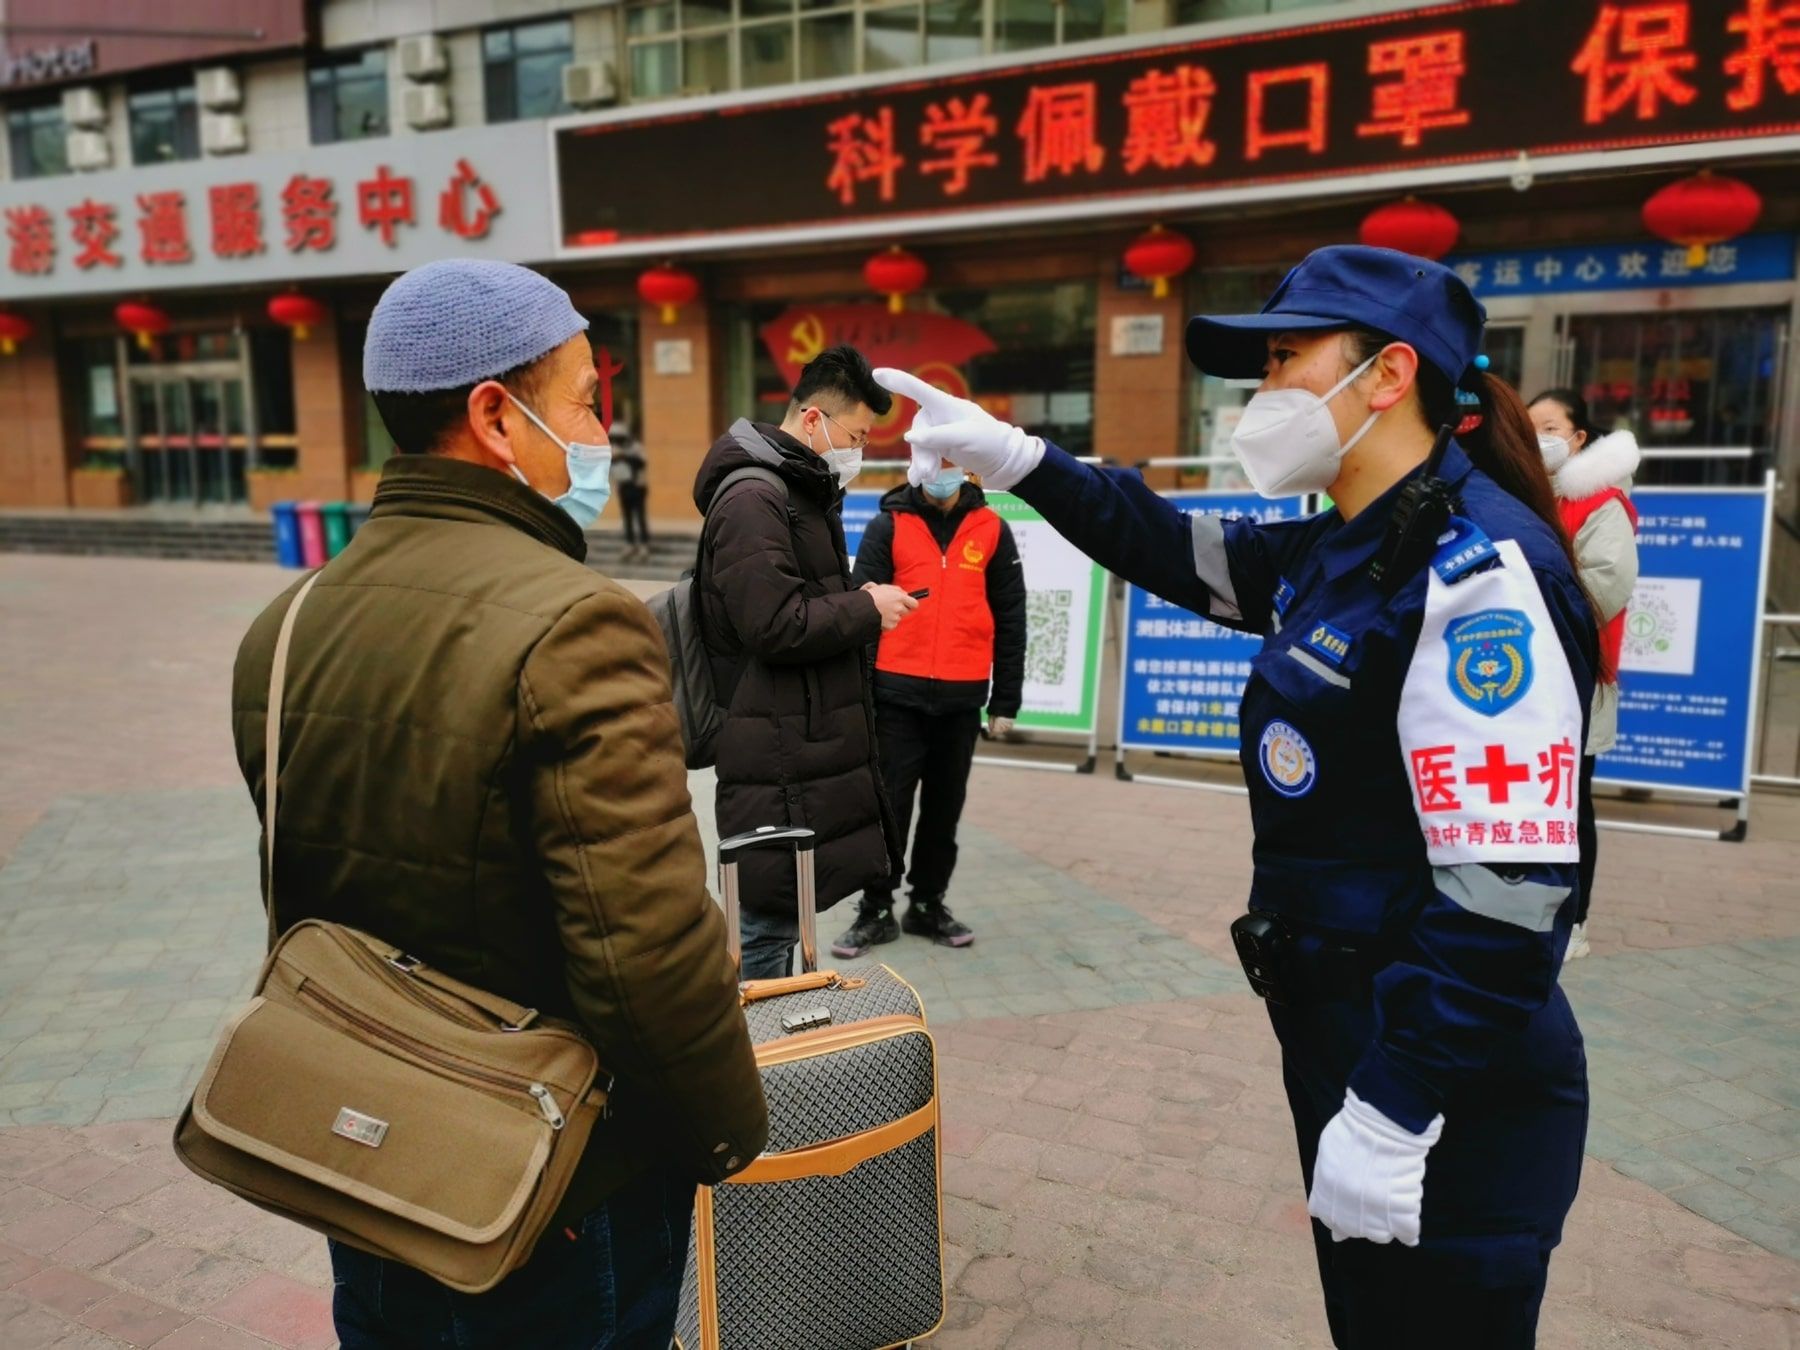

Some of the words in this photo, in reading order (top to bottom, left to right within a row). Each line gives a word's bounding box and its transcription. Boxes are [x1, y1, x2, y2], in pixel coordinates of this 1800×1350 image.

[827, 30, 1470, 205] 科学佩戴口罩
[4, 158, 503, 275] 游交通服务中心
[1411, 744, 1462, 813] 医
